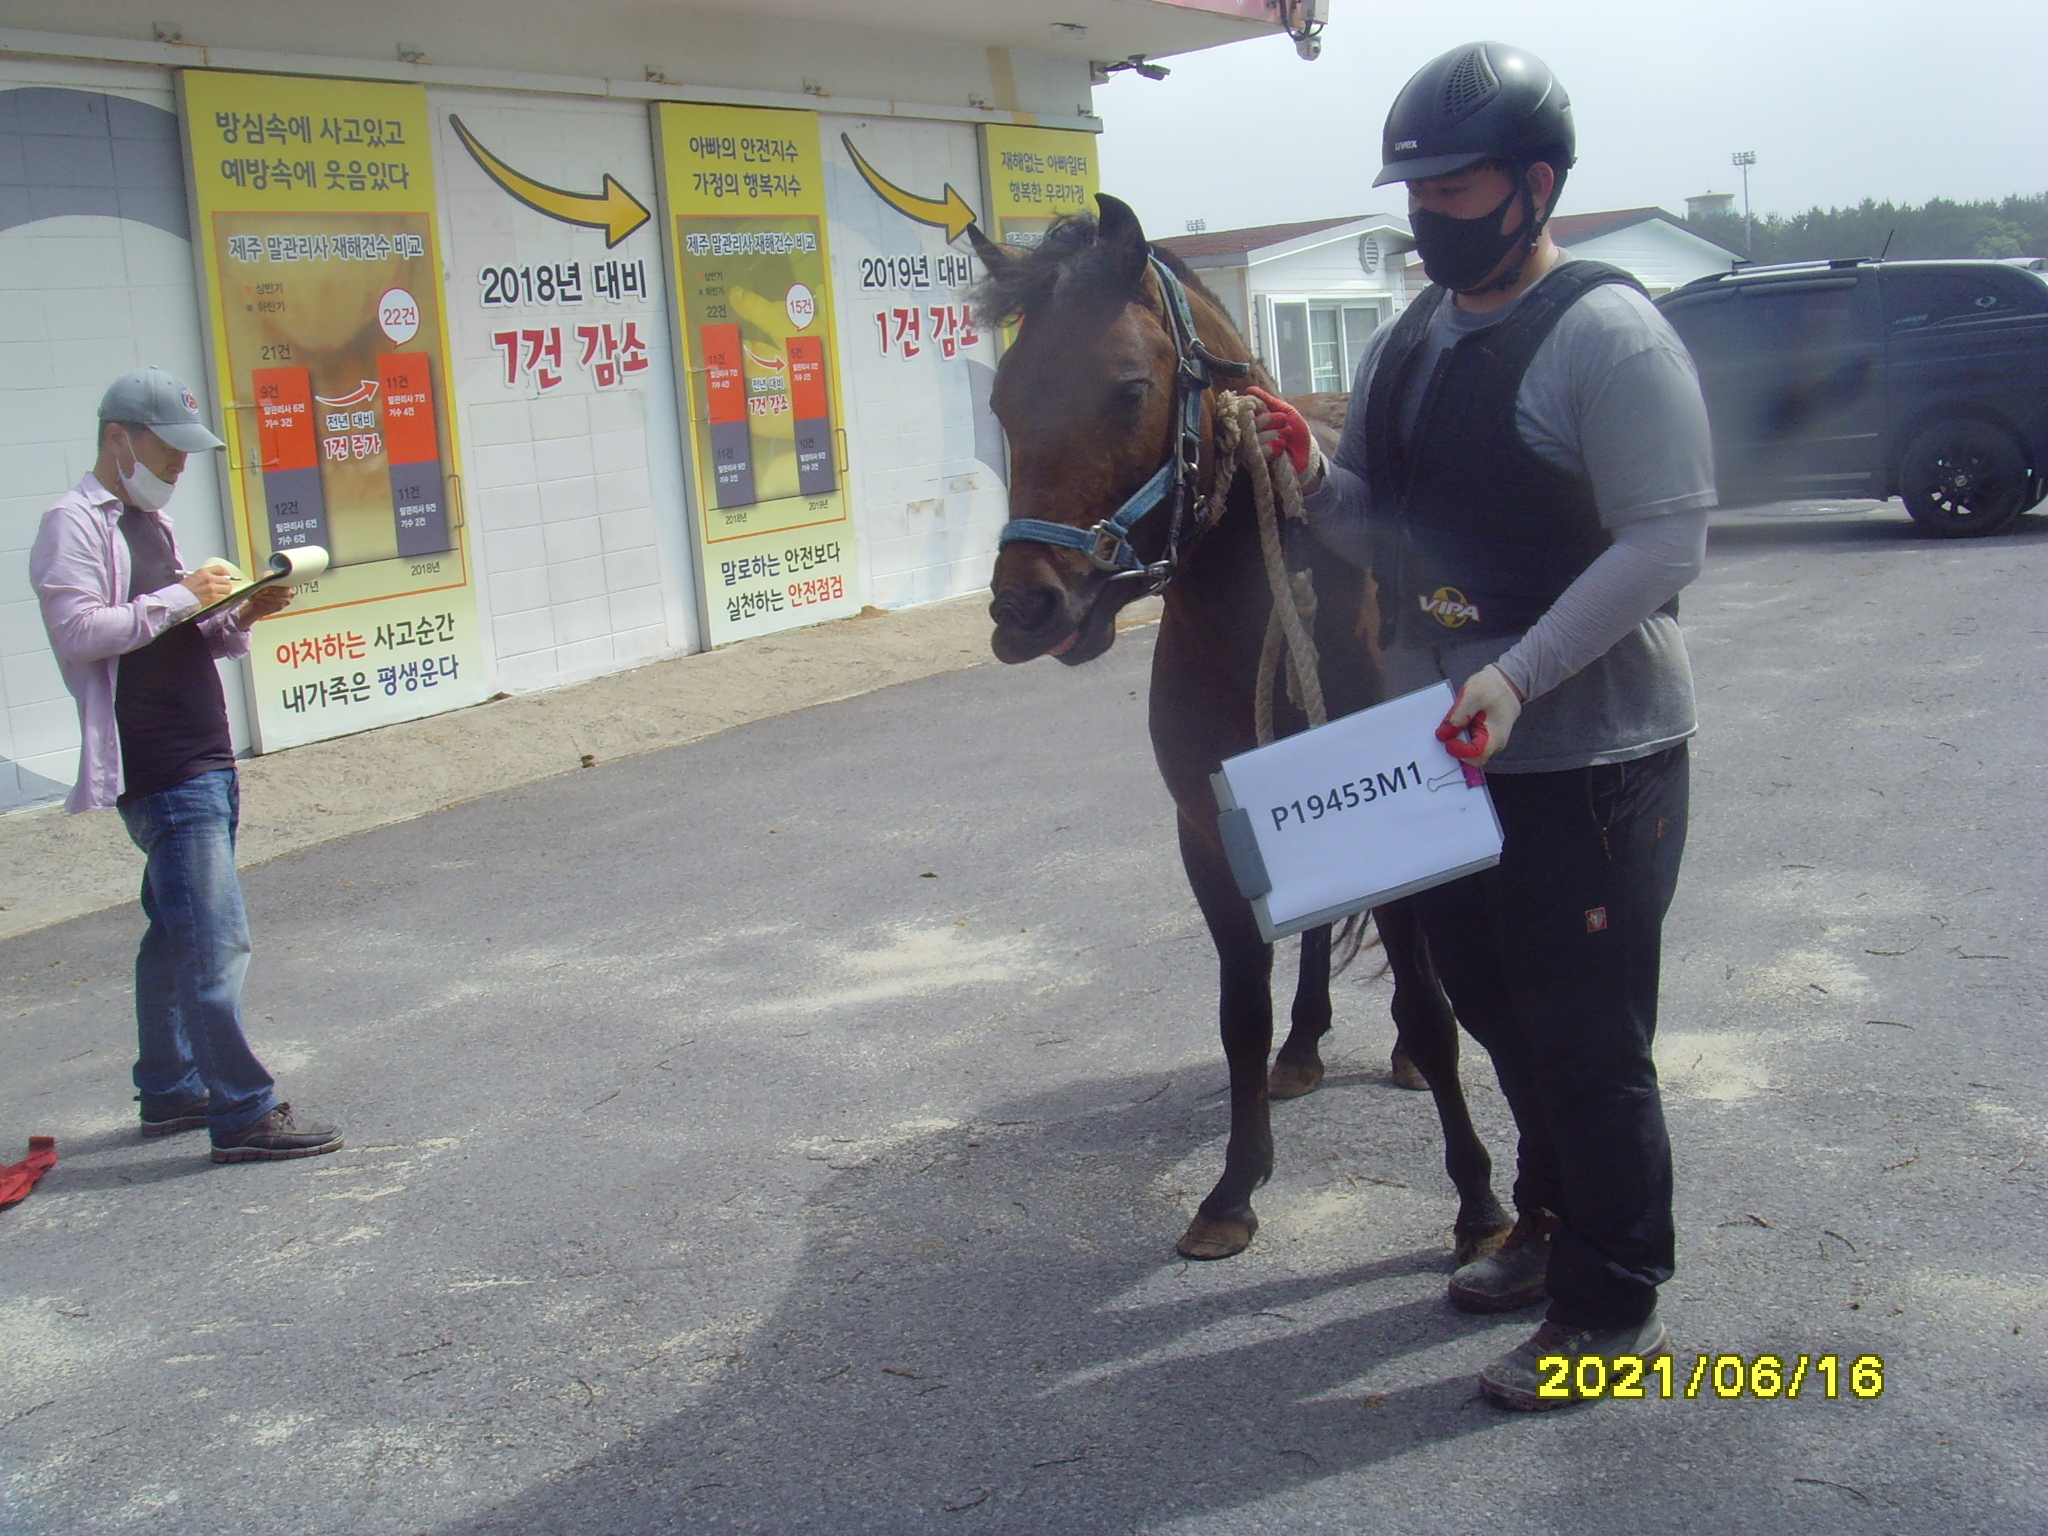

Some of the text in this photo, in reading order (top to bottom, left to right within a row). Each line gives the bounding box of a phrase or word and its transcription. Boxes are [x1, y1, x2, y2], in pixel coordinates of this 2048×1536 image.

[214, 112, 405, 148] 방심속에 사고있고
[689, 136, 799, 163] 아빠의 안전지수
[1395, 140, 1418, 151] uvex
[221, 158, 410, 191] 예방속에 웃음있다
[1001, 152, 1088, 175] 재해없는 아빠일터
[692, 173, 802, 198] 가정의 행복지수
[1009, 181, 1085, 205] 행복한 우리가정
[228, 233, 425, 262] 제주 말관리사 재해건수 비교
[686, 232, 816, 256] 제주 말관리사 재해건수 비교
[481, 259, 647, 304] 2018년 대비
[861, 255, 974, 288] 2019년 대비
[255, 282, 284, 295] 상반기
[257, 300, 286, 313] 하반기
[383, 307, 416, 326] 22건
[706, 304, 727, 318] 22건
[789, 298, 812, 314] 15건
[876, 305, 980, 358] 1건 감소
[261, 343, 292, 361] 21건
[494, 322, 649, 390] 7건 감소
[260, 384, 280, 399] 9건
[387, 375, 409, 389] 11건
[752, 376, 784, 392] 전년 대비
[768, 395, 789, 415] 감소
[326, 411, 375, 431] 전년 대비
[323, 433, 381, 462] 1건 증가
[398, 486, 420, 500] 11건
[275, 501, 299, 516] 12건
[808, 499, 829, 511] 2019년
[725, 512, 748, 525] 2018년
[410, 561, 441, 577] 2018년
[720, 541, 841, 587] 말로하는 안전보다
[726, 574, 844, 622] 실천하는 안전점검
[1417, 594, 1480, 622] VIPA
[276, 612, 455, 669] 아차하는 사고순간
[281, 653, 460, 714] 내가족은 평생운다
[1270, 761, 1423, 832] P19453M1
